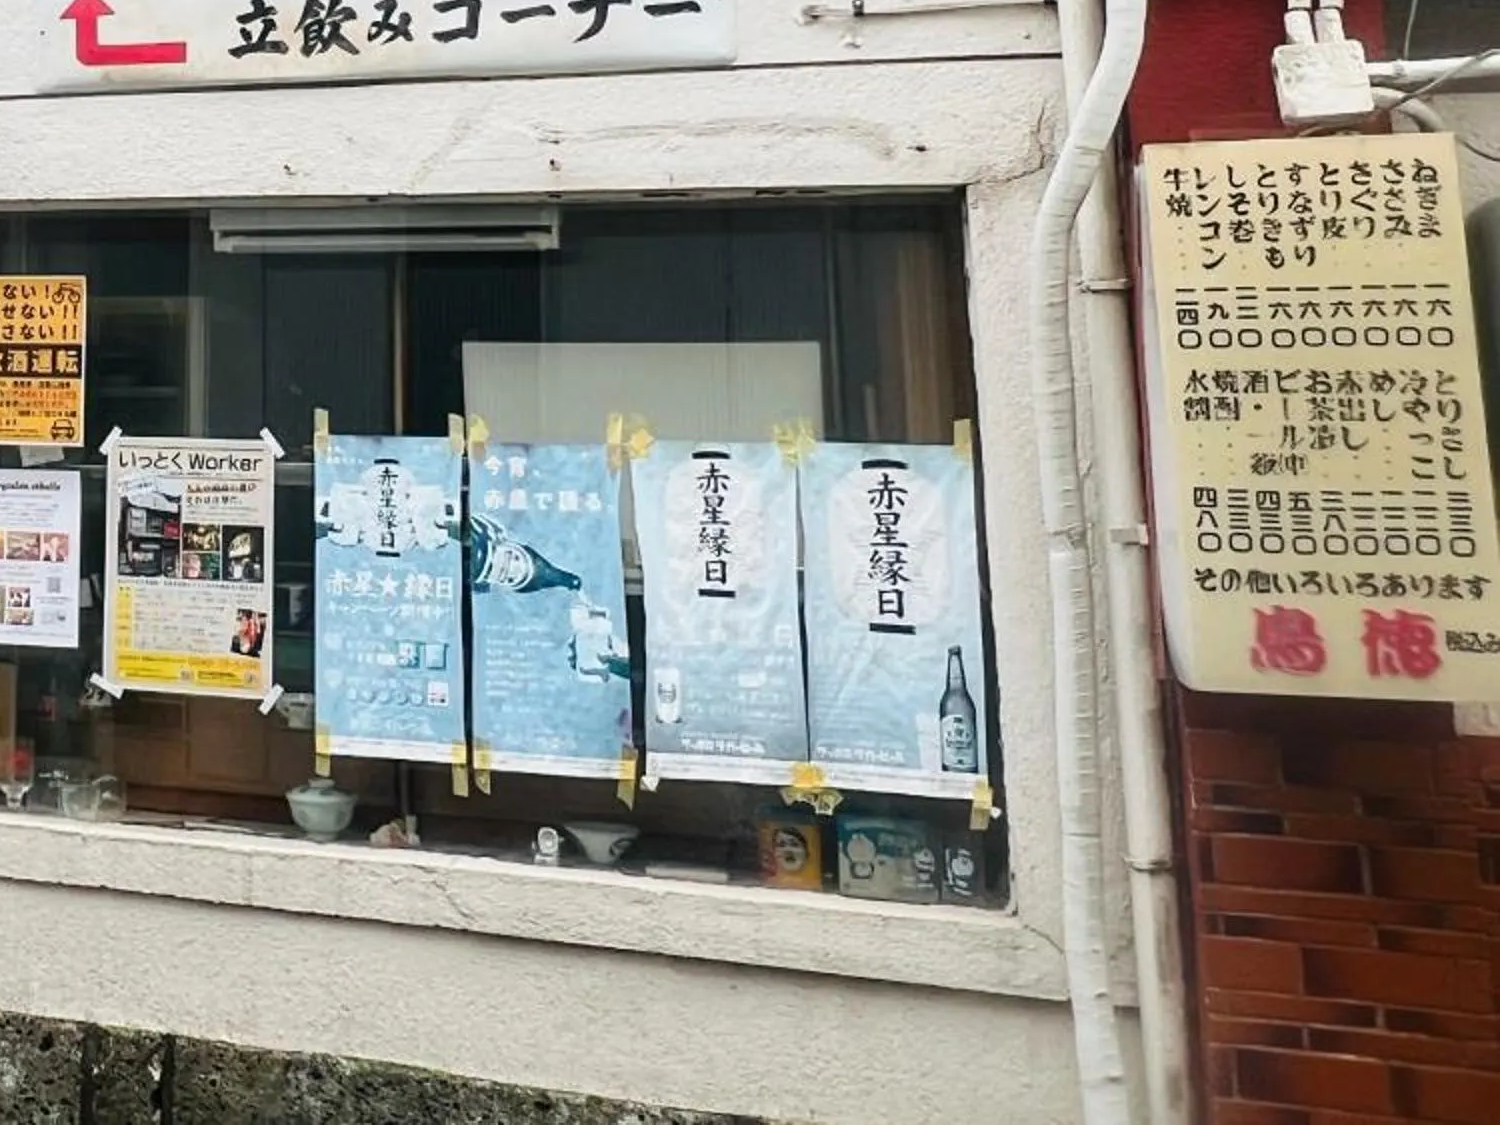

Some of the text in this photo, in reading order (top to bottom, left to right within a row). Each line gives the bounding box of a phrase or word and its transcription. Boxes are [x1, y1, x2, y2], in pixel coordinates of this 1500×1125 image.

[1193, 168, 1227, 269] レンコン
[1226, 165, 1256, 242] しそ巻
[1257, 165, 1285, 268] とりきも
[1284, 163, 1316, 267] すなずり
[1319, 163, 1348, 239] とり皮
[1380, 159, 1413, 238] ささみ
[1369, 369, 1397, 421] めし
[119, 452, 263, 472] いっとく Worker
[697, 463, 732, 585] 赤星縁日
[867, 474, 911, 619] 赤星縁日
[1194, 568, 1491, 600] その他いろいろあります
